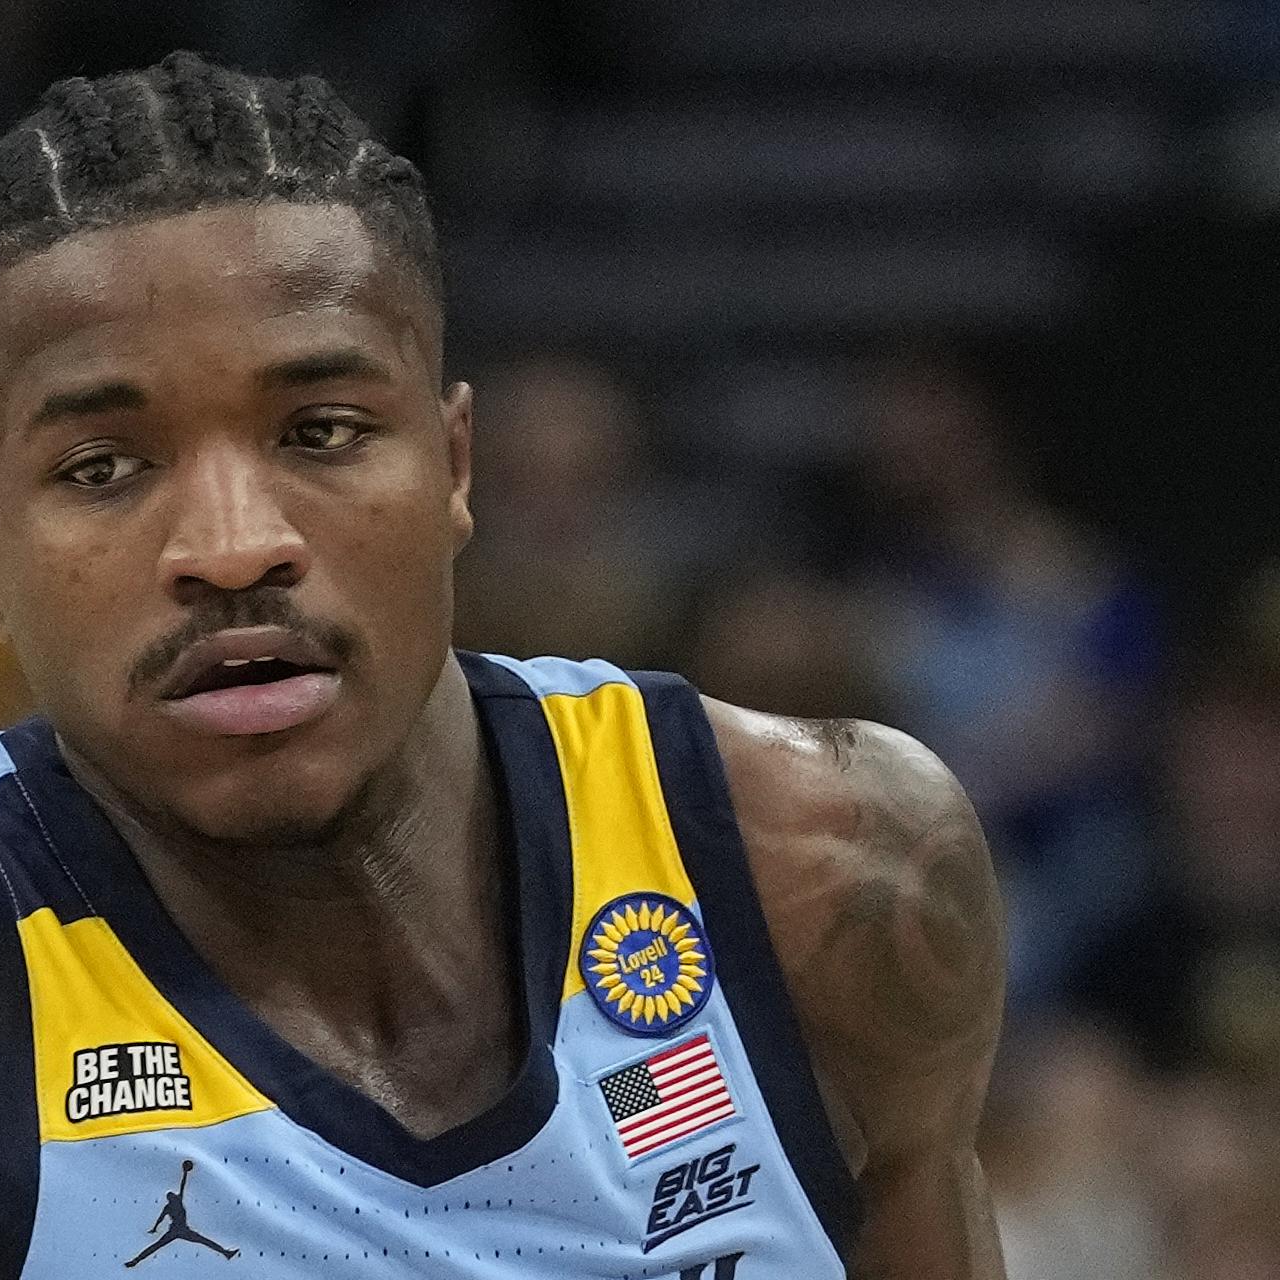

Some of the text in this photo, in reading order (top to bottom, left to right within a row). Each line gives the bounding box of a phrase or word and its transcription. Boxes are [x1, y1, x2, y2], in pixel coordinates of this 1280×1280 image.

[617, 936, 669, 975] Lovell
[640, 964, 666, 989] 24
[76, 1045, 181, 1086] BE THE
[67, 1076, 191, 1121] CHANGE
[653, 1142, 737, 1203] BIG
[646, 1163, 761, 1236] EAST
